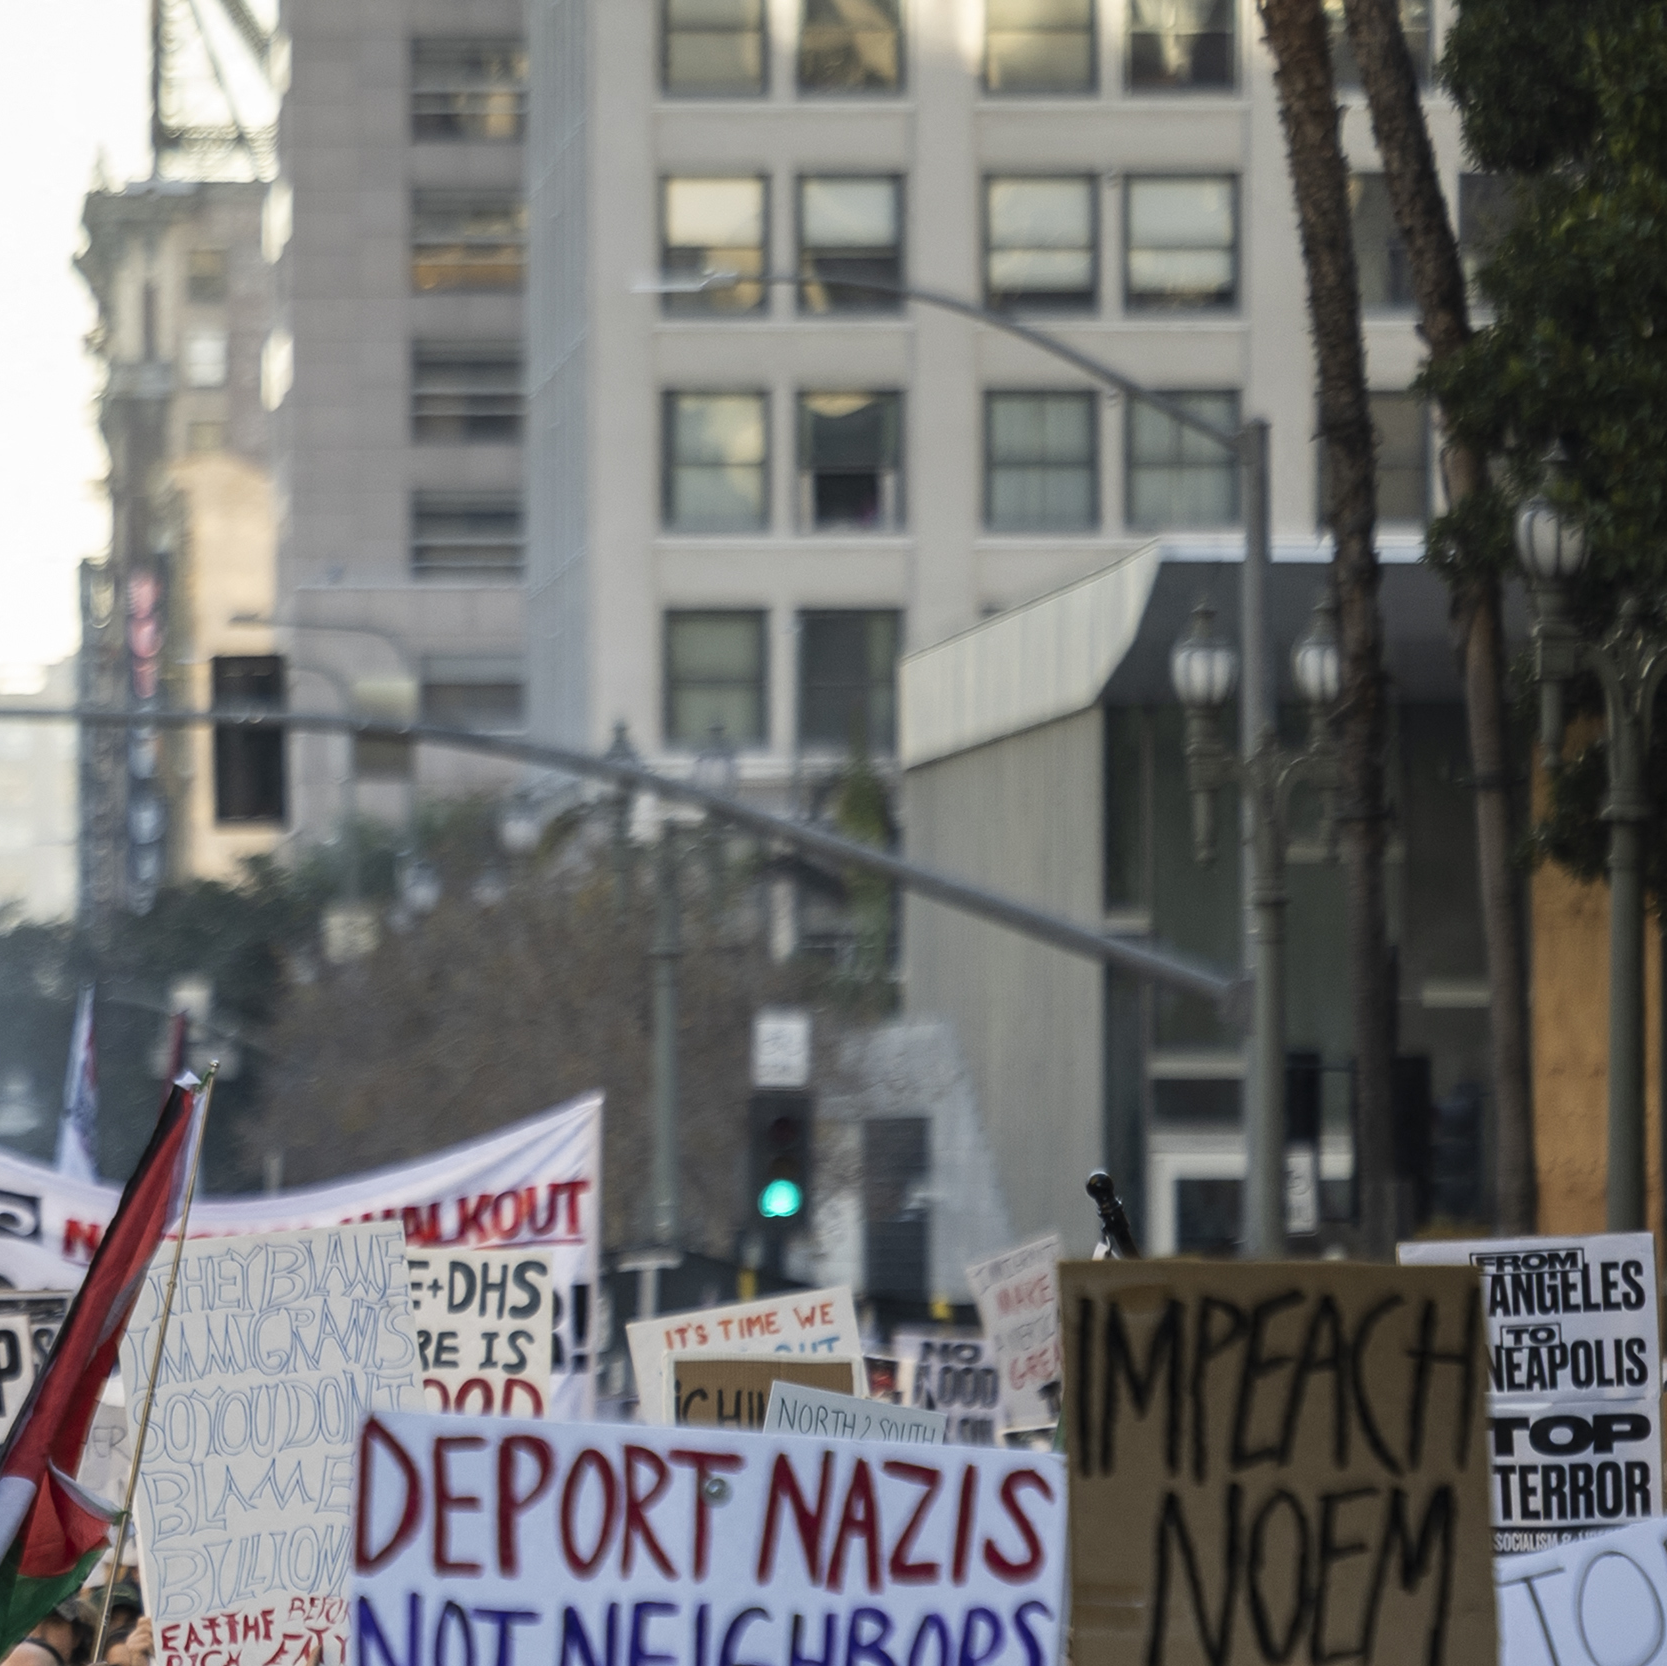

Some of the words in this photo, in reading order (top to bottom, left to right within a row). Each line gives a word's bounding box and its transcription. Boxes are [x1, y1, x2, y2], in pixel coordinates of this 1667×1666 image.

[148, 1245, 264, 1322] THEY
[260, 1231, 409, 1313] BLAME
[1476, 1251, 1579, 1273] FROM
[1488, 1260, 1646, 1318] ANGELES
[126, 1299, 416, 1397] IMMIGRANTS
[479, 1329, 535, 1374] IS
[664, 1323, 710, 1351] IT'S
[717, 1311, 782, 1343] TIME
[793, 1301, 834, 1328] WE
[920, 1341, 983, 1365] NO
[1506, 1327, 1557, 1346] TO
[1076, 1287, 1483, 1485] IMPEACH
[1487, 1337, 1649, 1393] NEAPOLIS
[133, 1392, 196, 1463] SO
[191, 1383, 280, 1458] YOU
[777, 1398, 857, 1438] NORTH
[879, 1418, 936, 1443] SOUTH
[1488, 1413, 1651, 1457] TOP
[141, 1456, 353, 1548] BLAME
[351, 1414, 744, 1584] DEPORT
[757, 1450, 1056, 1596] NAZIS
[1491, 1461, 1652, 1521] TERROR
[1494, 1530, 1559, 1552] SOCIALISM
[151, 1524, 351, 1622] BILLION
